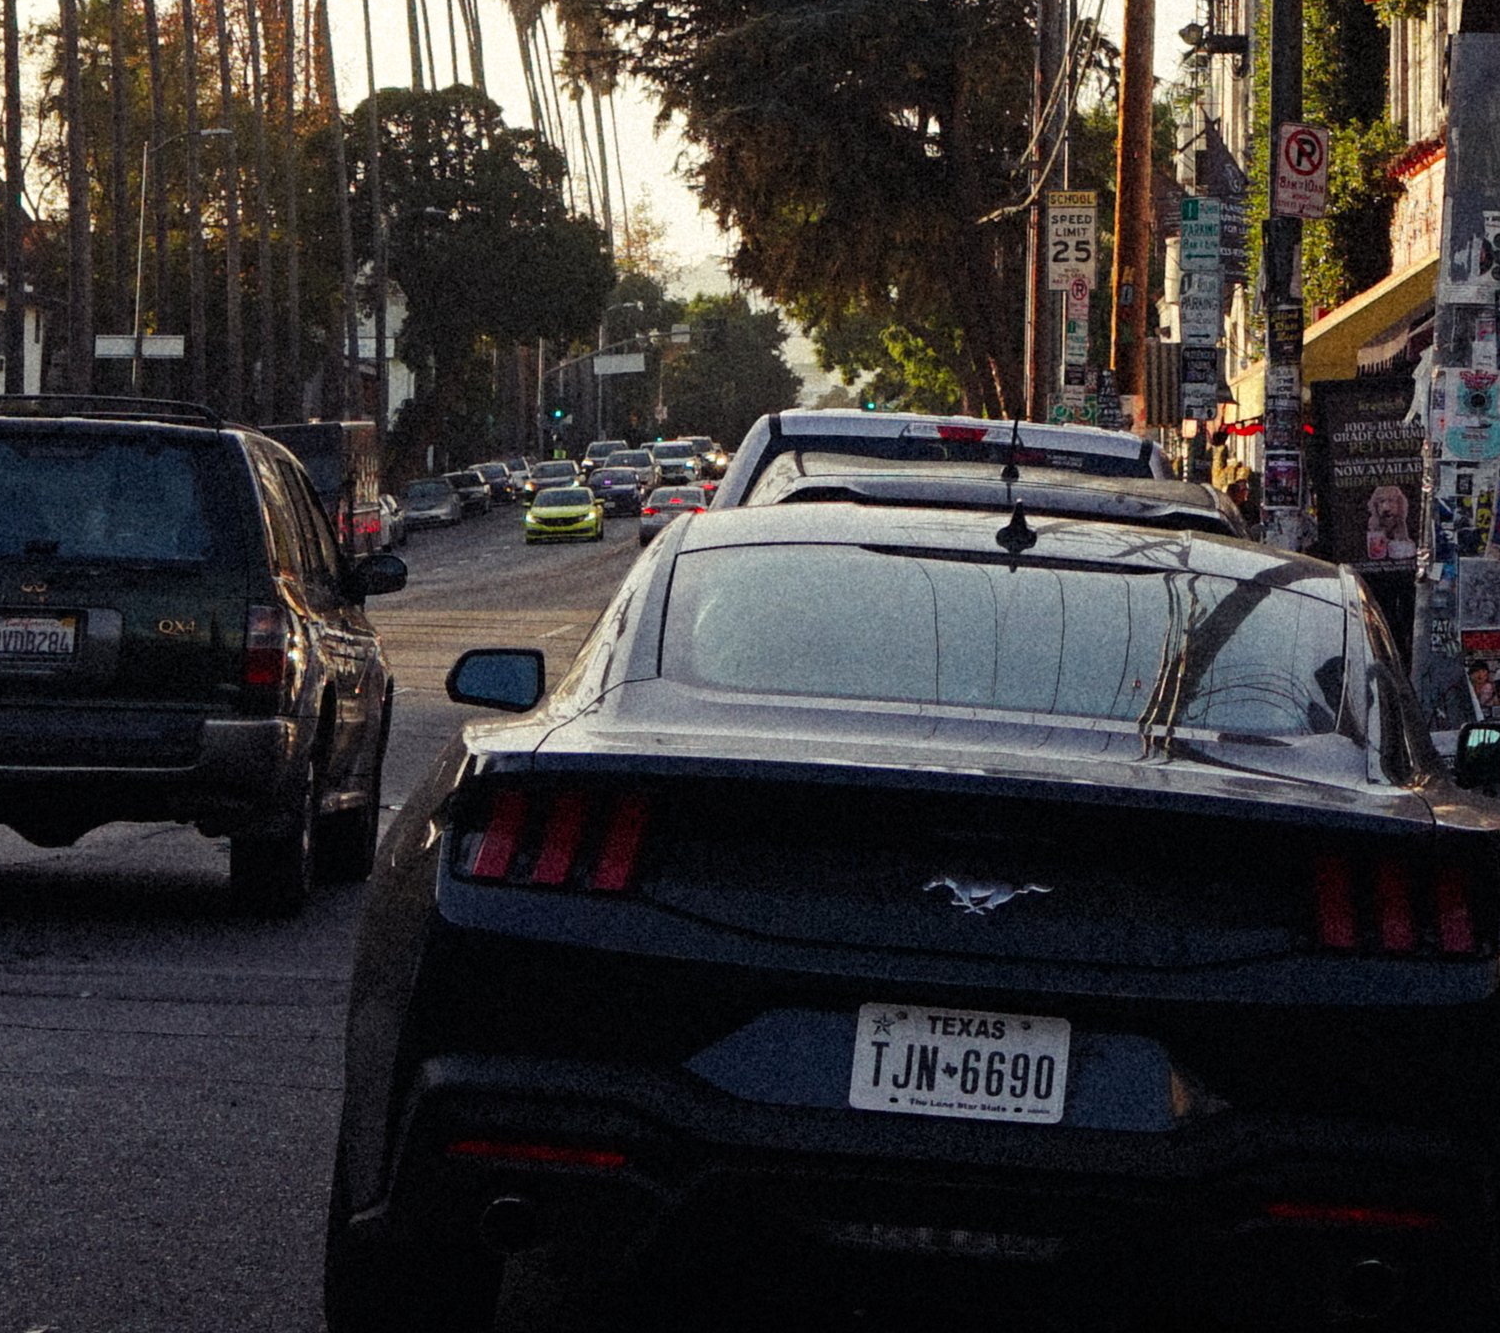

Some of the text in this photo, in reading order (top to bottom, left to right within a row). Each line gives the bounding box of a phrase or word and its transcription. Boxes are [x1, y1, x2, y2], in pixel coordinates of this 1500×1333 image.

[1050, 194, 1094, 205] SCHOOL
[1051, 214, 1093, 225] SPEED
[1055, 227, 1088, 238] LIMIT
[1052, 240, 1092, 263] 25
[158, 619, 196, 636] QX4
[927, 1014, 1006, 1040] TEXAS
